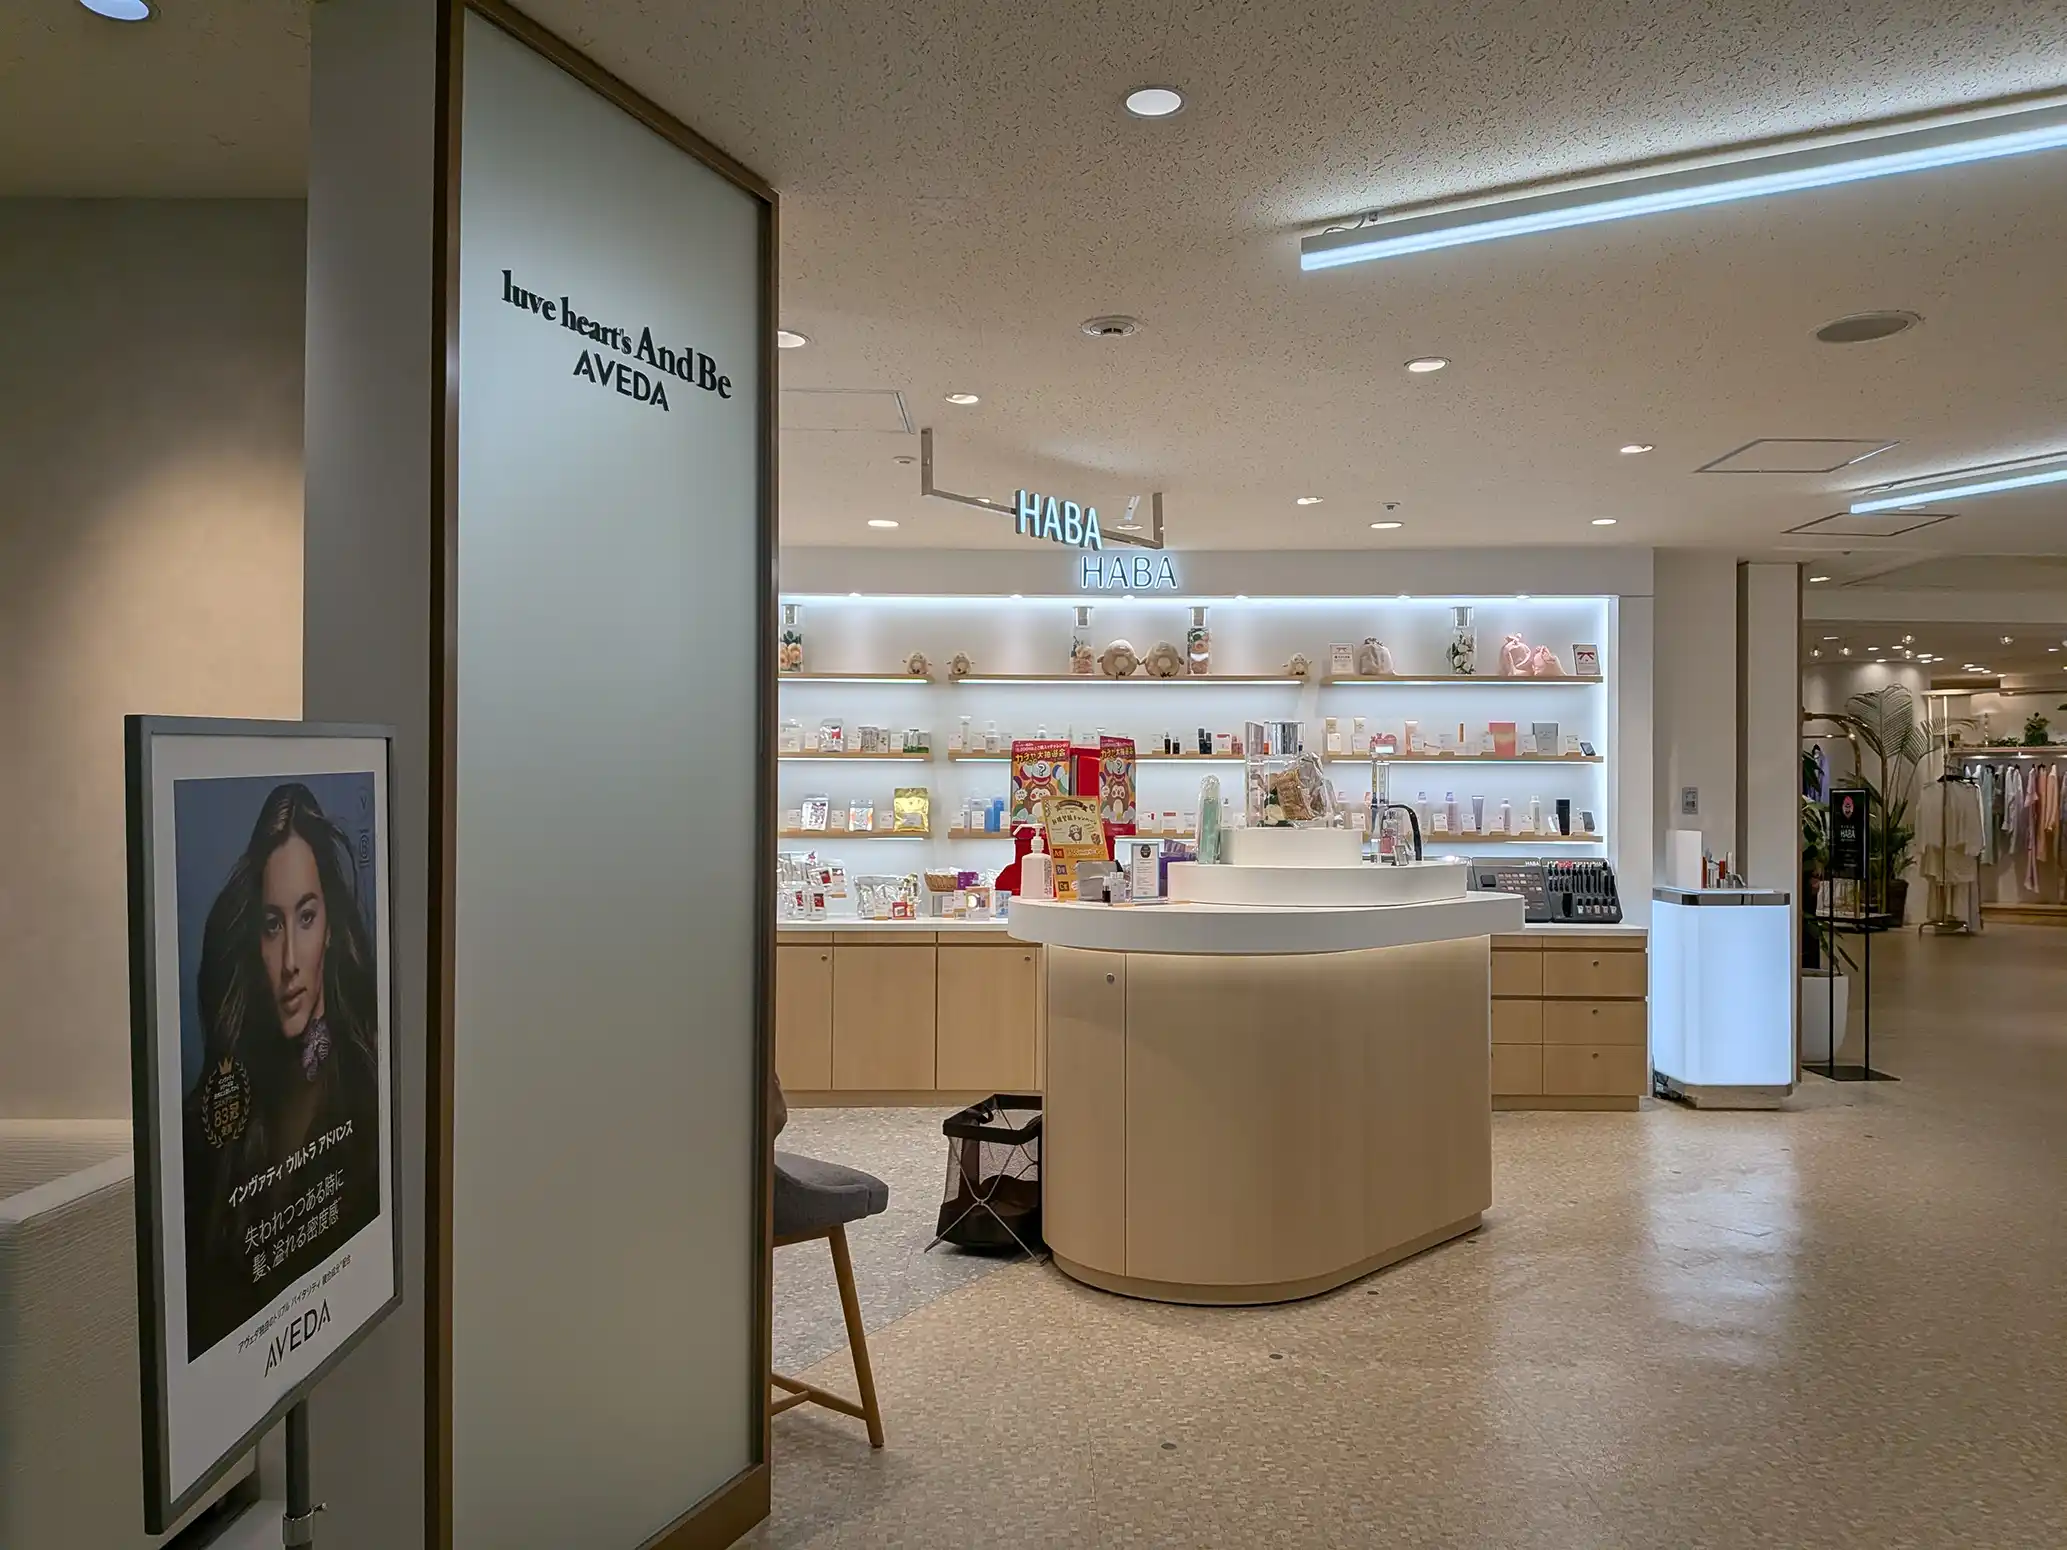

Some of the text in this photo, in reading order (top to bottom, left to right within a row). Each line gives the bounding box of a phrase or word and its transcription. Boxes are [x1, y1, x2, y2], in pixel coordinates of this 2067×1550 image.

[501, 269, 732, 399] luve heart's And Be
[573, 349, 669, 412] AVEDA
[1016, 489, 1103, 550] HABA
[1080, 555, 1178, 590] HABA
[228, 1119, 354, 1207] インヴァティ ウルトラ アドバンス
[244, 1168, 345, 1255] 失われつつある時に
[264, 1298, 332, 1378] AVEDA
